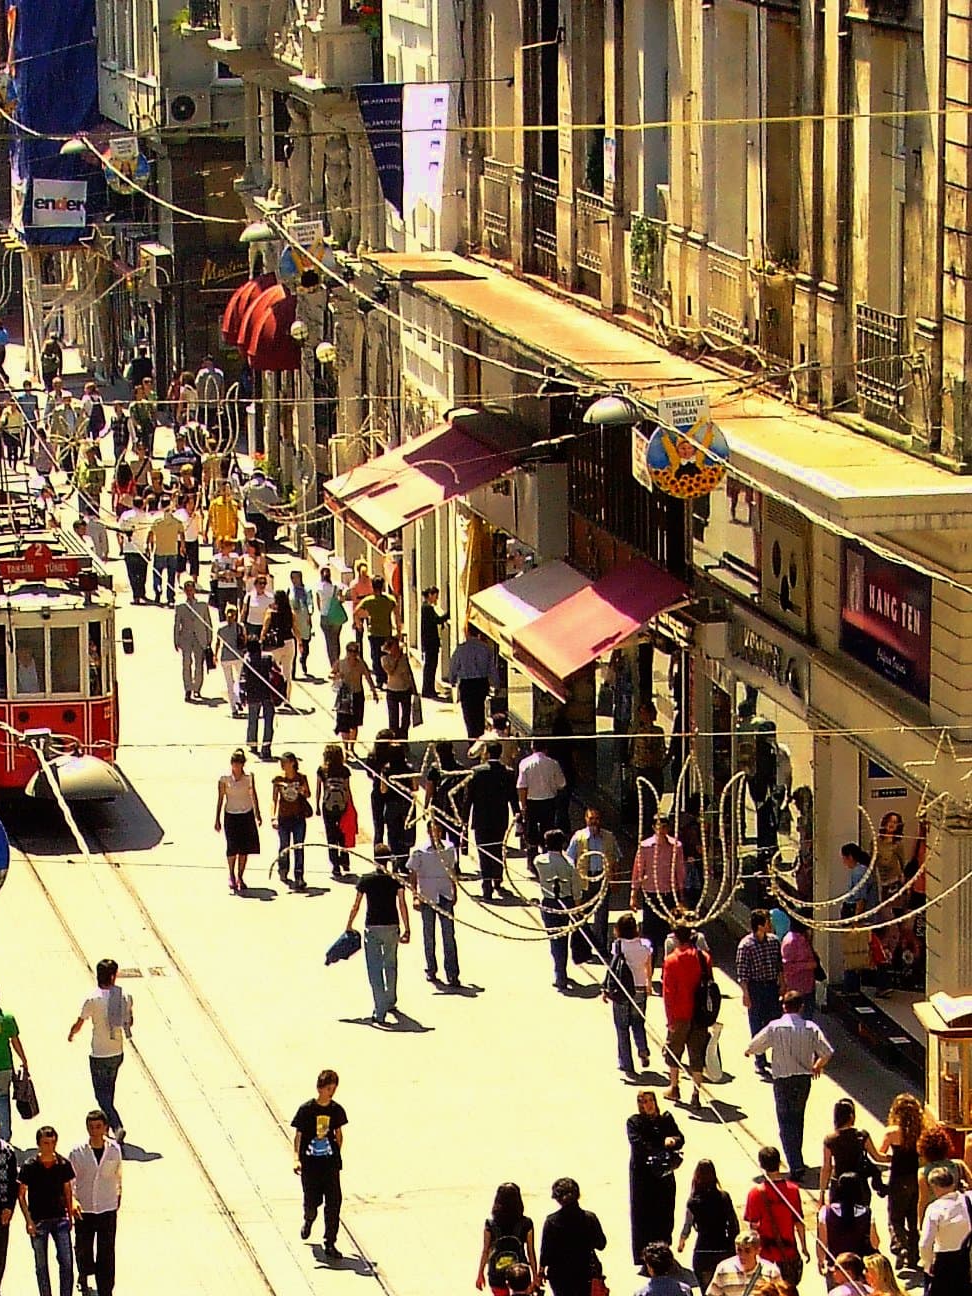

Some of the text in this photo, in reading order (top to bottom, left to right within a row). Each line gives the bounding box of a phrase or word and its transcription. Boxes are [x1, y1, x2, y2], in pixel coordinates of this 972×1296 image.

[34, 543, 44, 557] 2
[869, 583, 921, 636] HANG TEN
